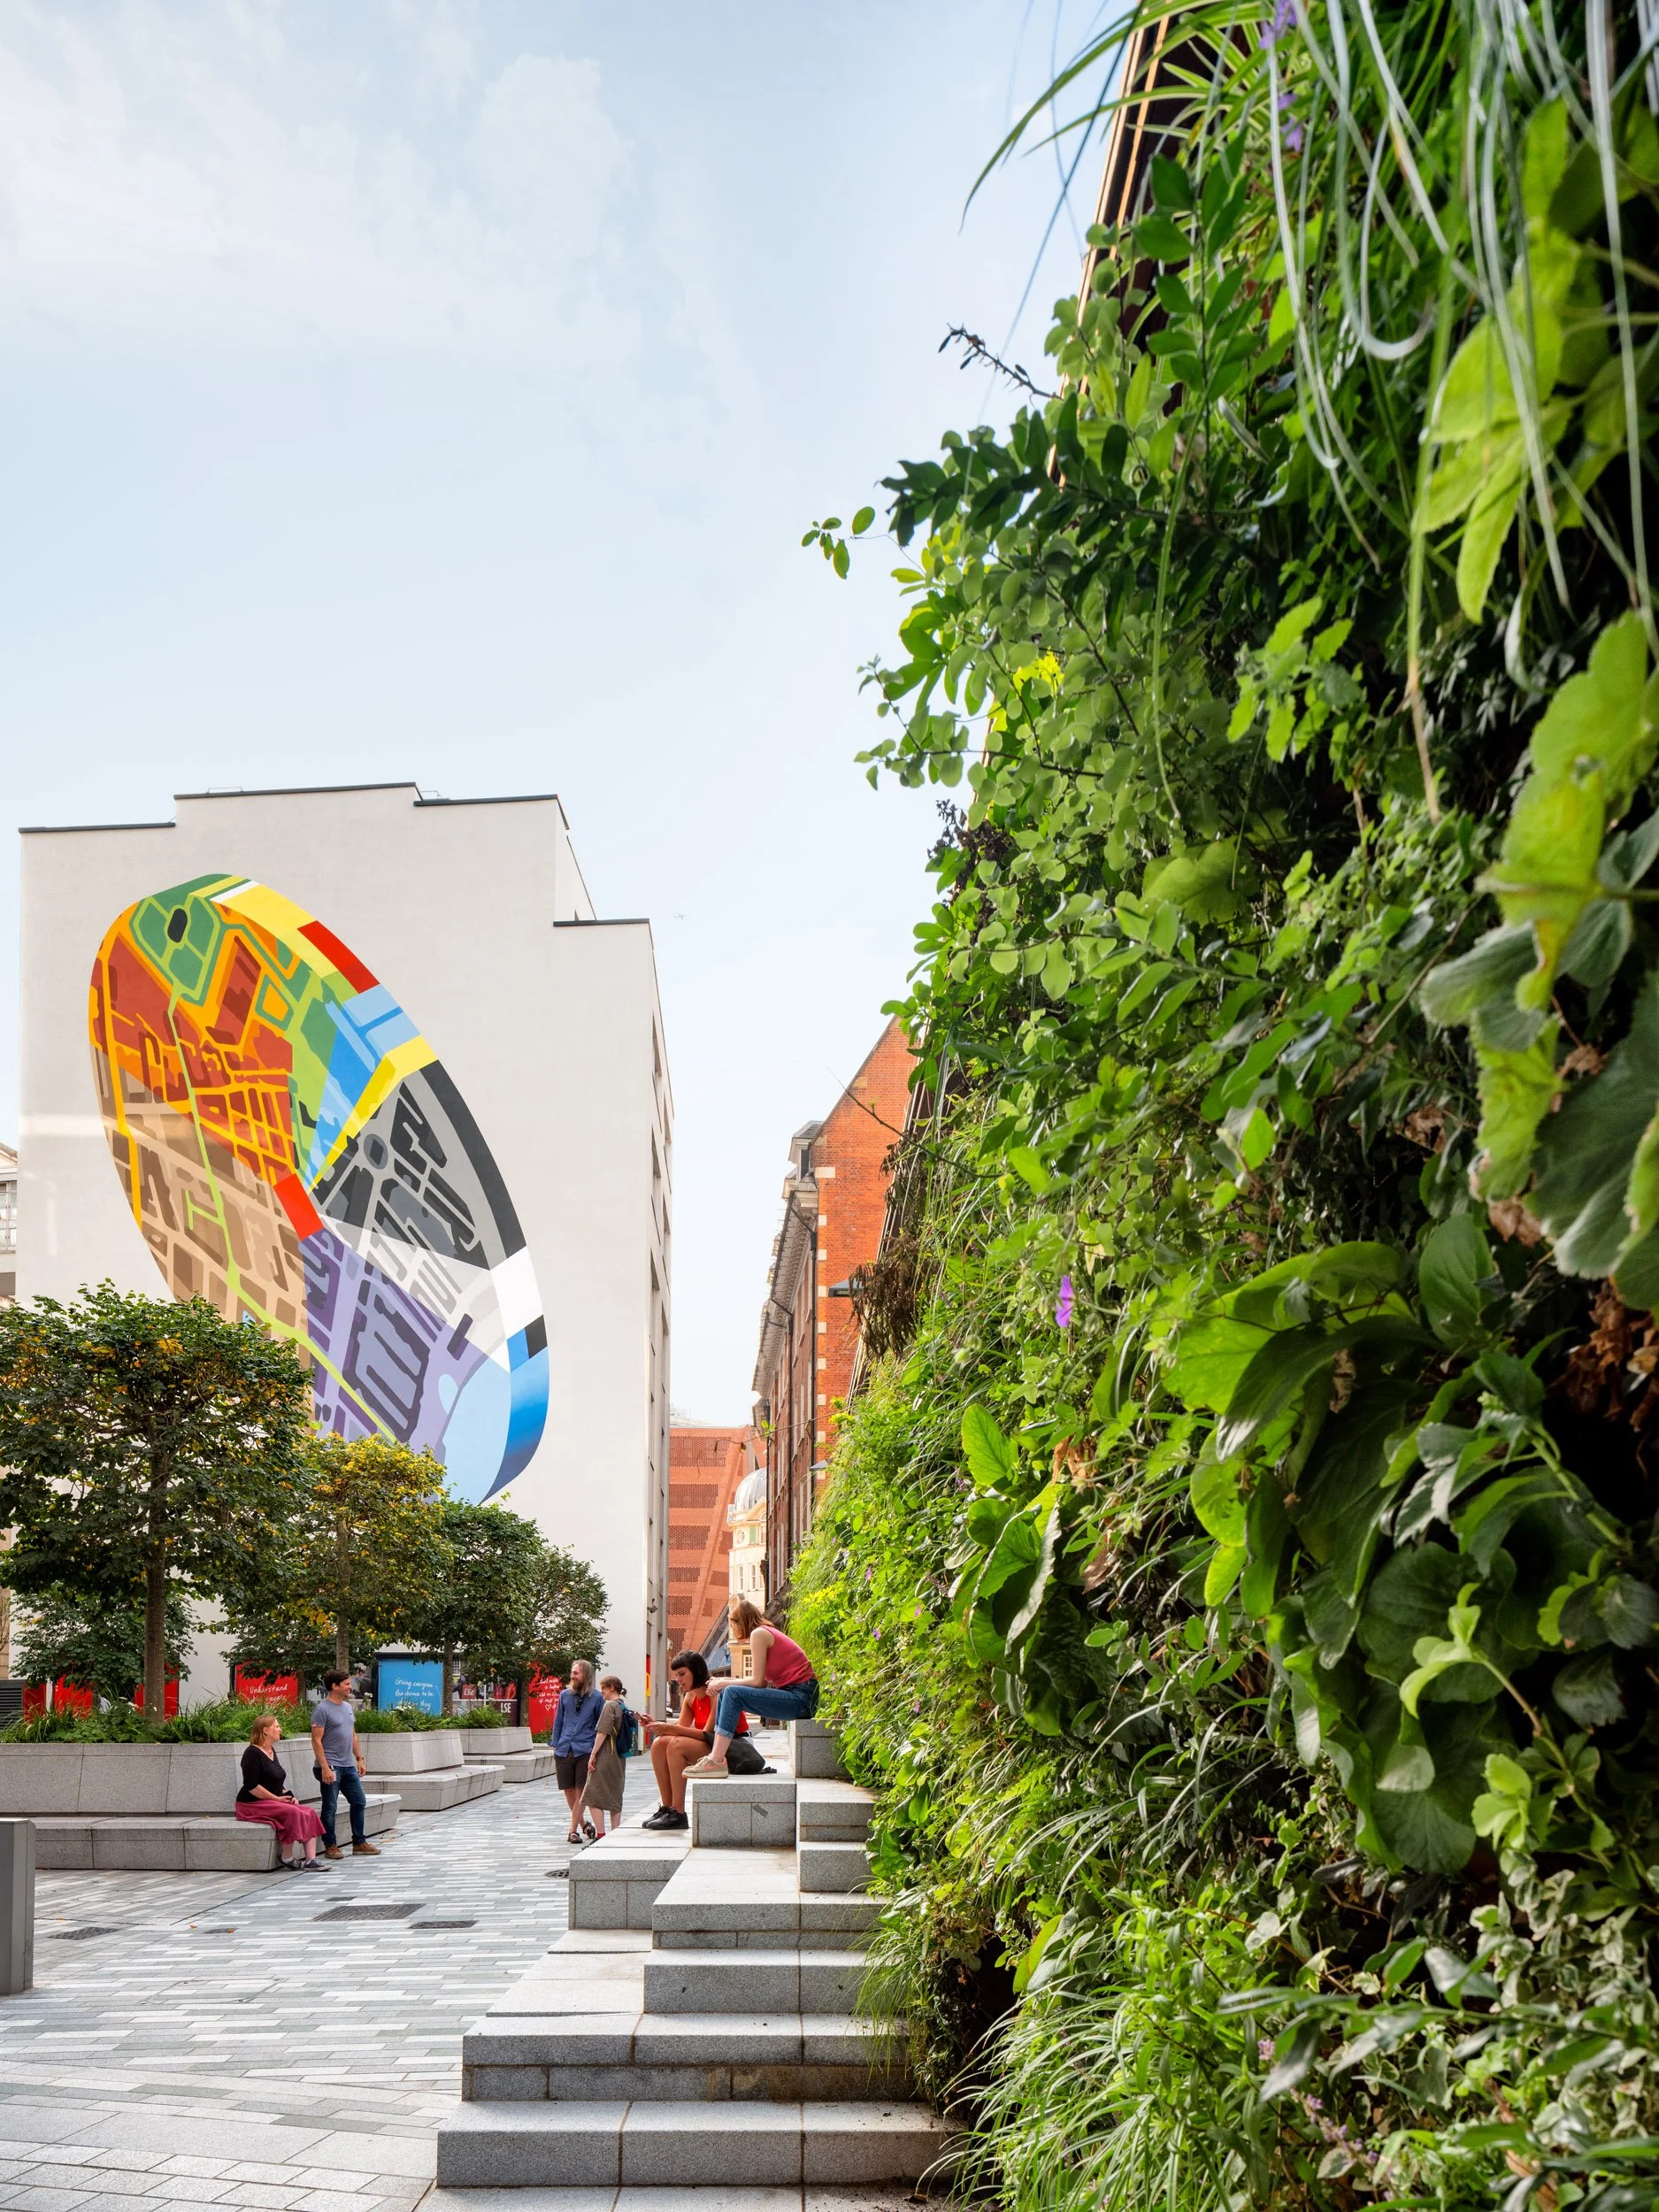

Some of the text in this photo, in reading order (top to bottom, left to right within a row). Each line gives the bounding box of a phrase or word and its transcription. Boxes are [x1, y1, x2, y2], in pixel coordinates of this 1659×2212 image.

[250, 1683, 288, 1694] Understand
[395, 1678, 411, 1690] Giving
[500, 1702, 511, 1714] LSE
